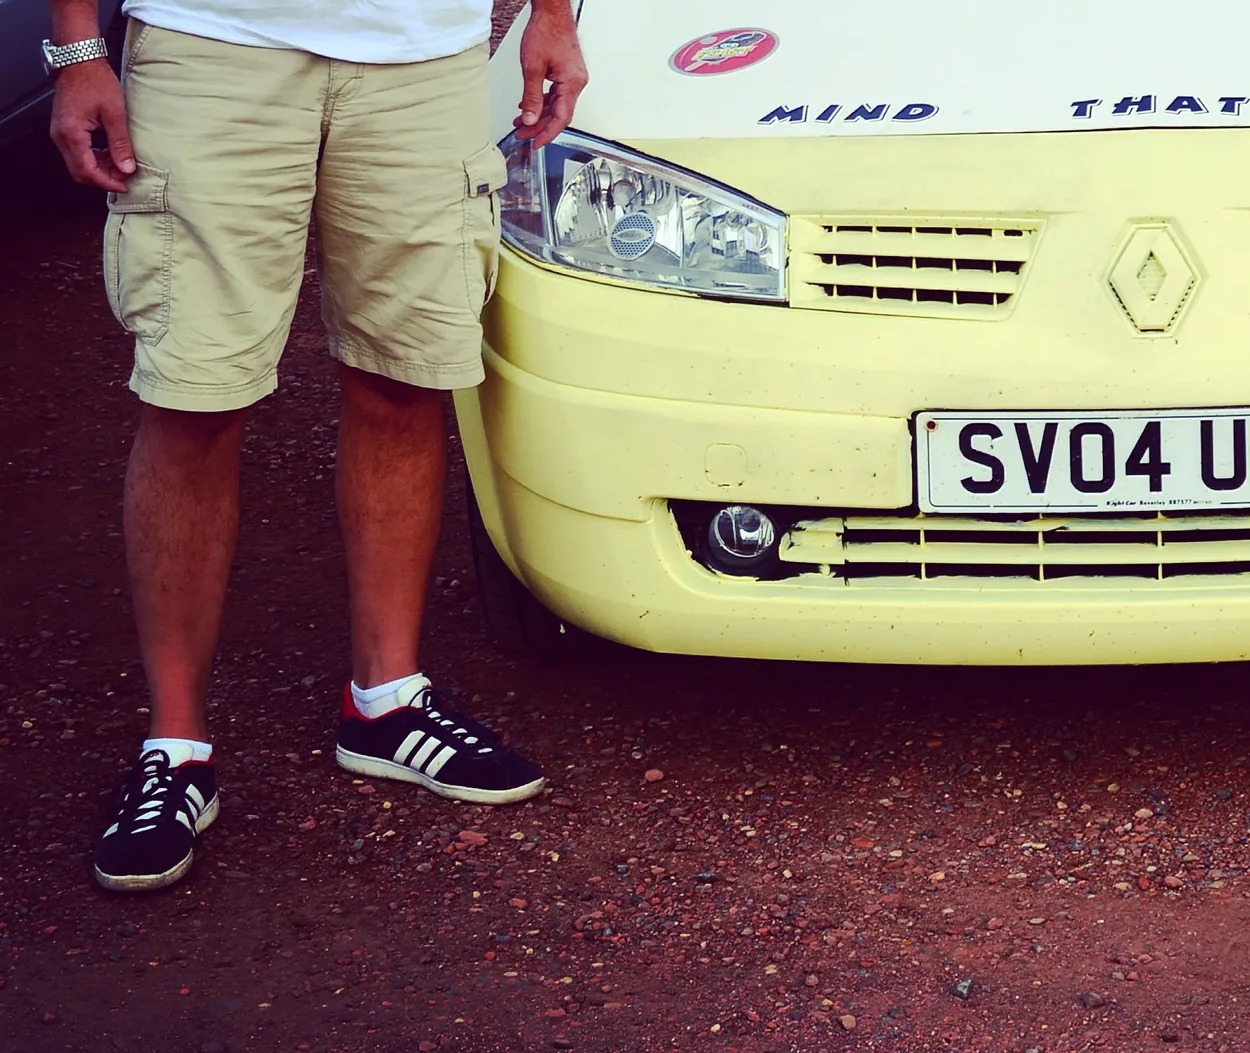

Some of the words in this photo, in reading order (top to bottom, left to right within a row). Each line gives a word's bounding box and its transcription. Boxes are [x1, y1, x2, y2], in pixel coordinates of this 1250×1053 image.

[757, 103, 940, 125] MIND
[1070, 95, 1250, 119] THAT
[958, 421, 1171, 494] SV04
